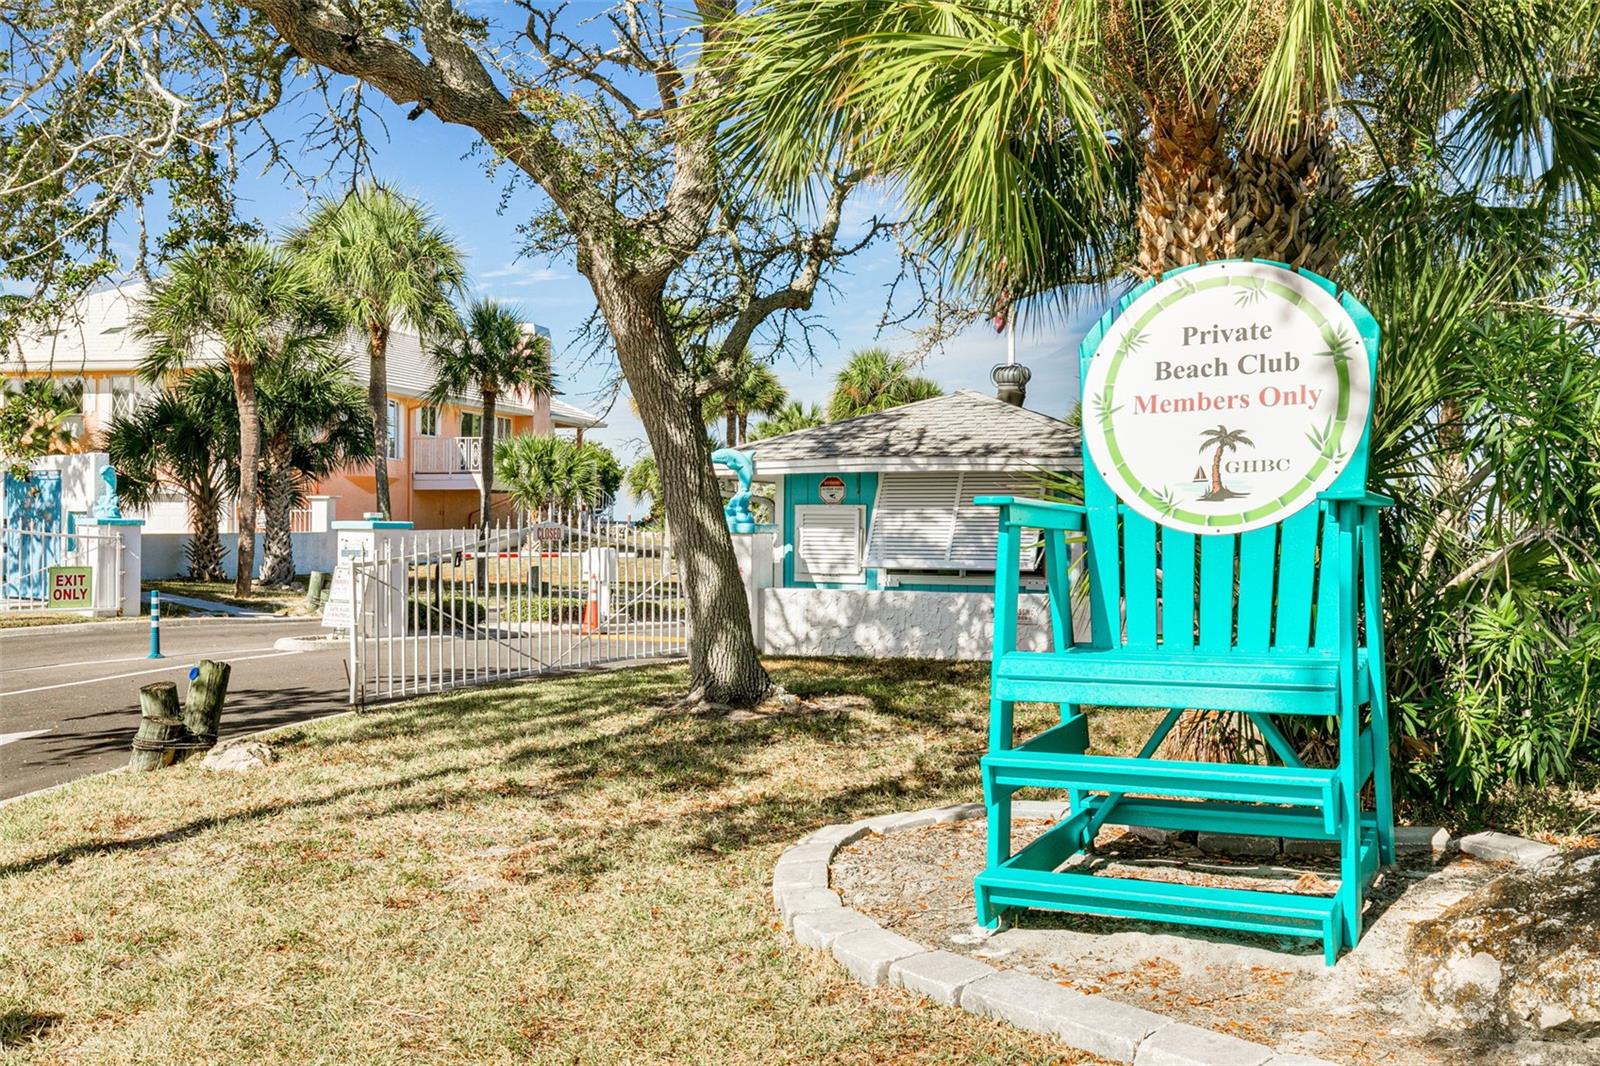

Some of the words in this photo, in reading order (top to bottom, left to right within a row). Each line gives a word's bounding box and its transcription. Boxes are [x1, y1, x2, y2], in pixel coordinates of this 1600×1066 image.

[1182, 322, 1272, 346] Private
[1155, 357, 1229, 381] Beach
[1237, 352, 1300, 375] Club
[1133, 392, 1250, 415] Members
[1259, 385, 1322, 410] Only
[1225, 458, 1290, 474] GHBC
[537, 527, 561, 539] CLOSED
[56, 575, 86, 586] EXIT
[53, 588, 88, 601] ONLY
